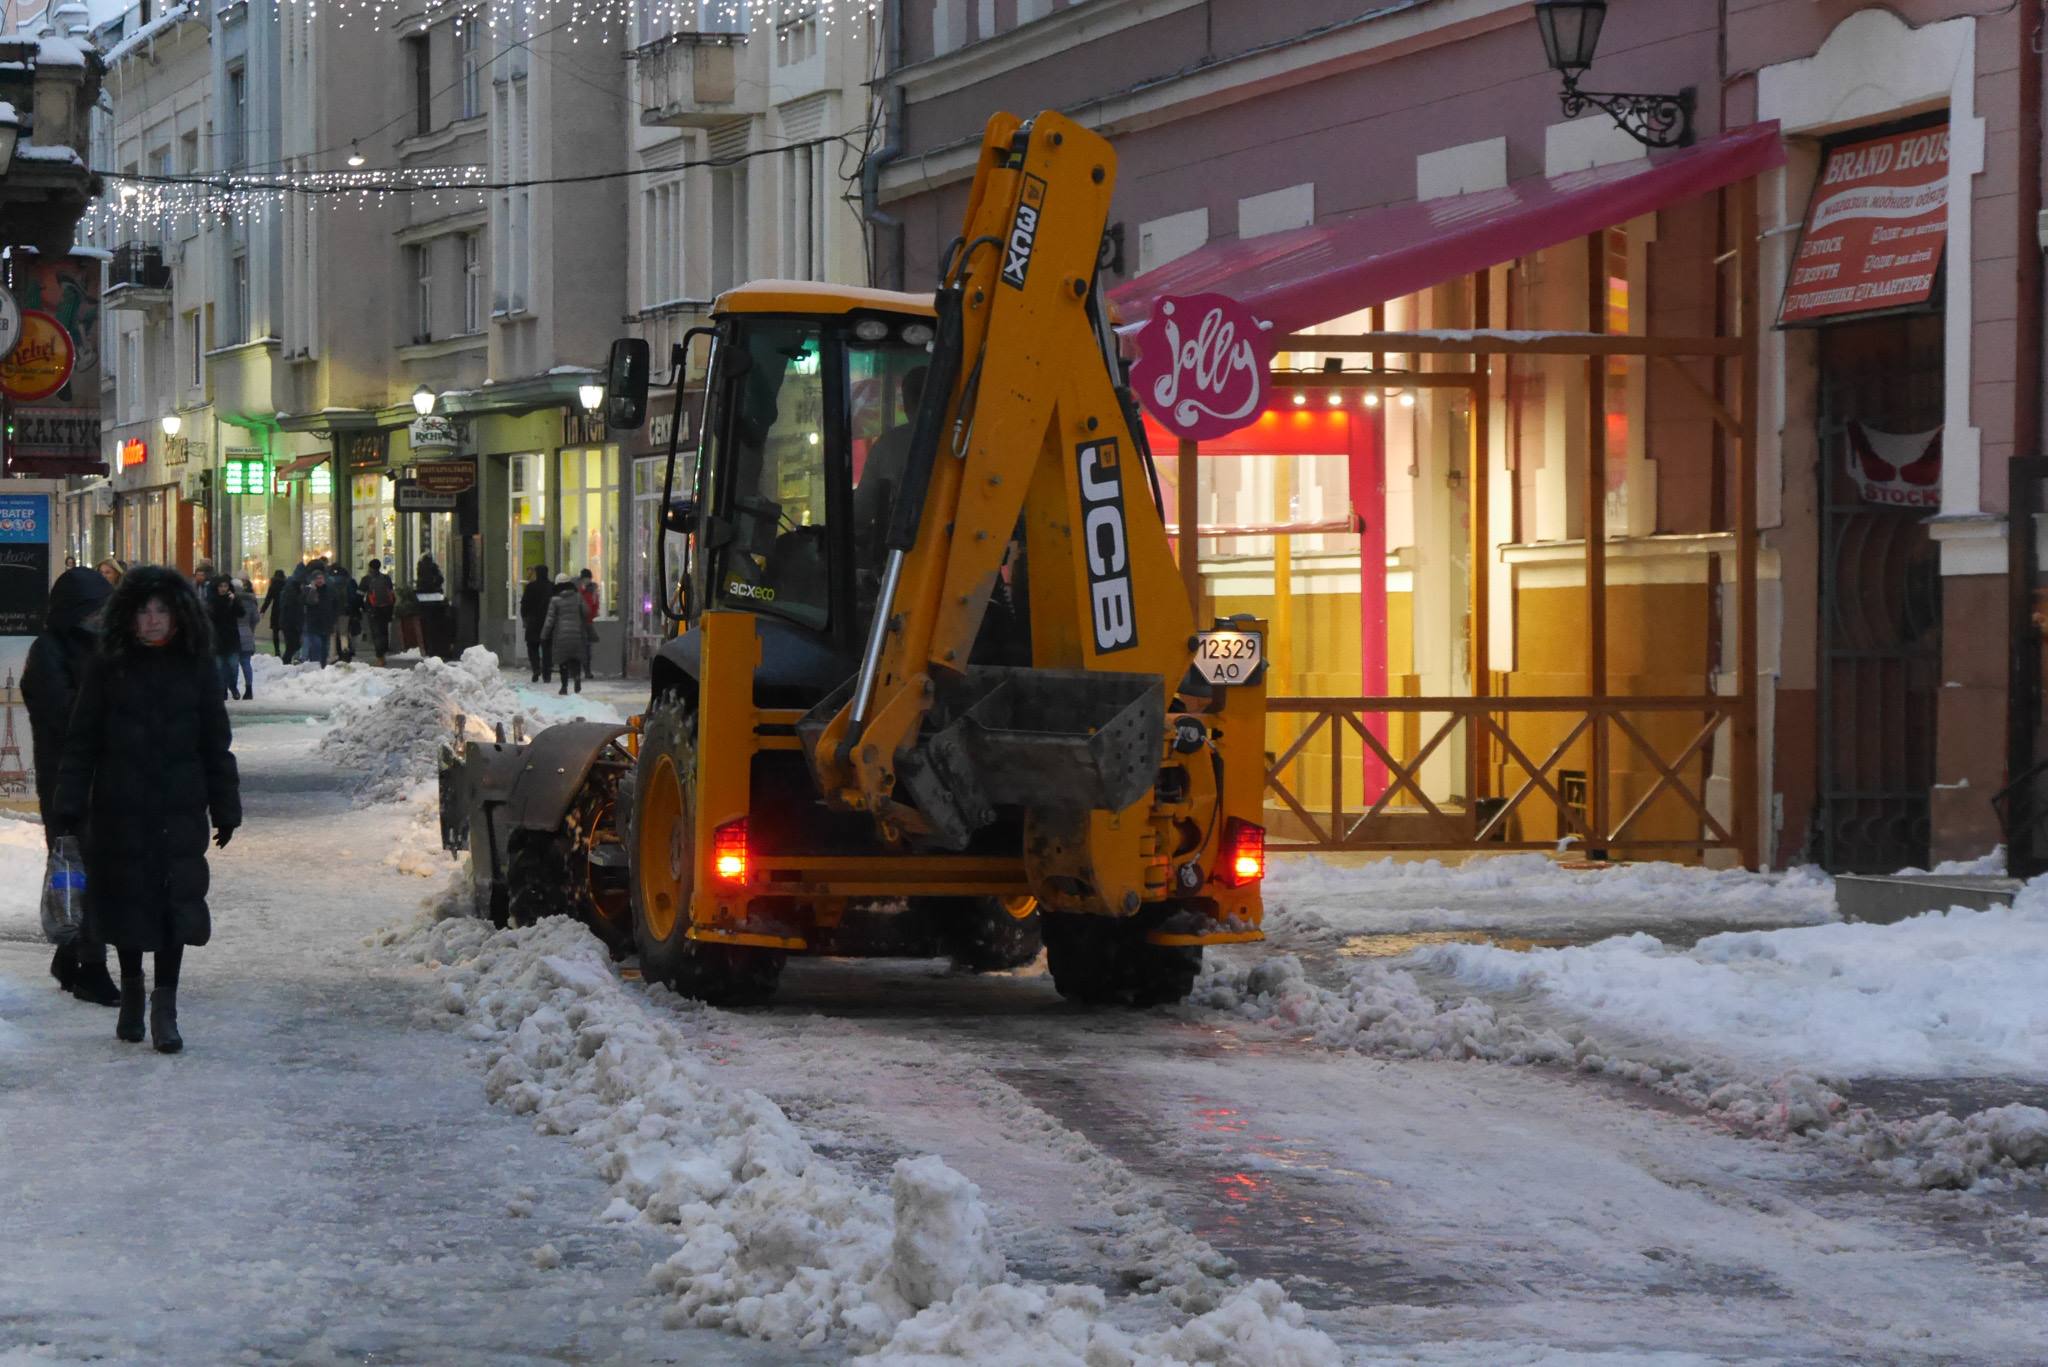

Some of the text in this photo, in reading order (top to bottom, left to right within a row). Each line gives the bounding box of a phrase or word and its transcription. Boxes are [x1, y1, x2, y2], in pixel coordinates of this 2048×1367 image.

[1824, 144, 1894, 185] BRAND
[1004, 205, 1037, 281] 3CX
[649, 410, 691, 447] СЕКУДА
[1866, 484, 1939, 505] STOCK
[0, 509, 35, 519] ВАТЕР
[1081, 447, 1132, 649] JCB
[1199, 639, 1256, 660] 12329
